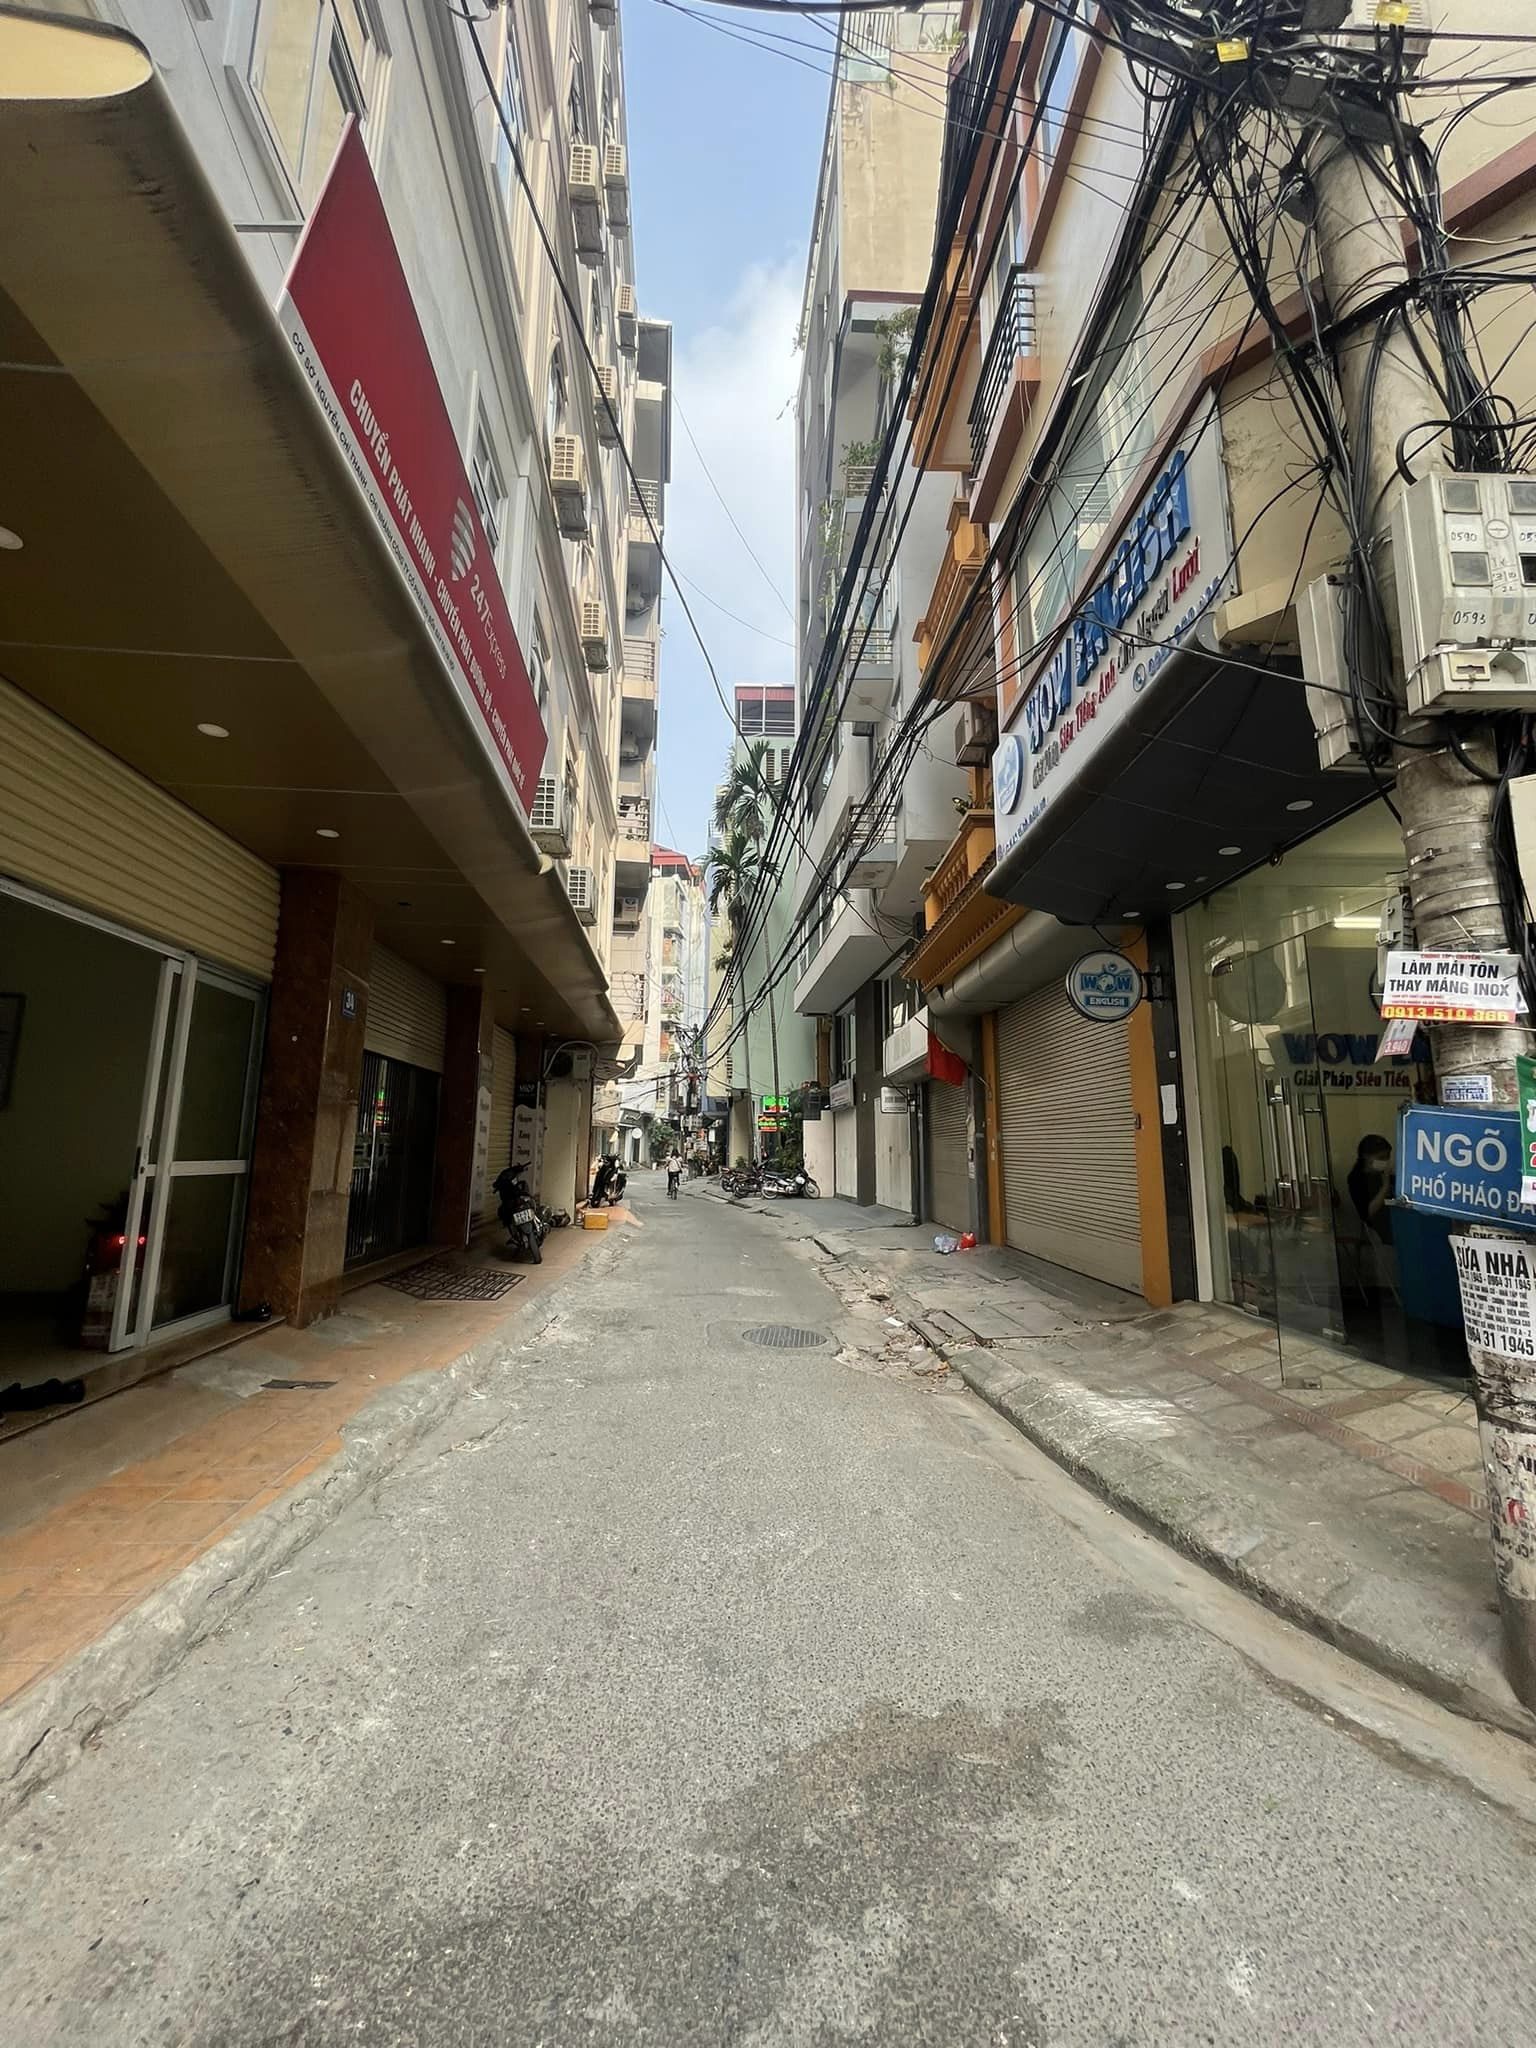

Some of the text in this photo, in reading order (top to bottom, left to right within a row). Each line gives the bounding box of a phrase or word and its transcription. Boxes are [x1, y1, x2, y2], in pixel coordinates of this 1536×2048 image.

[350, 453, 368, 489] THANH
[350, 379, 391, 476] CHUYỂN
[388, 465, 414, 523] PHÁT
[408, 514, 436, 579] NHANH
[457, 629, 473, 665] PHÁT
[1098, 658, 1116, 704] Anh
[1172, 535, 1200, 603] Lười
[1025, 638, 1073, 754] WOW
[1401, 959, 1499, 979] LÀM MÁI TÔN
[345, 991, 355, 1010] 34
[1389, 979, 1422, 993] THAY
[1473, 983, 1510, 997] INOX
[1281, 1032, 1379, 1065] WOW
[1322, 1070, 1353, 1089] Pháp
[1355, 1070, 1381, 1087] Siêu
[1417, 1128, 1508, 1172] NGÕ
[1412, 1172, 1446, 1199] PHỐ
[1451, 1180, 1502, 1210] PHÁO
[1456, 1238, 1480, 1272] SỬA
[1485, 1250, 1530, 1279] NHÀ
[1504, 1277, 1512, 1288] 31
[1515, 1279, 1531, 1291] 1945
[1483, 1330, 1495, 1349] 31
[1500, 1335, 1534, 1356] 1945
